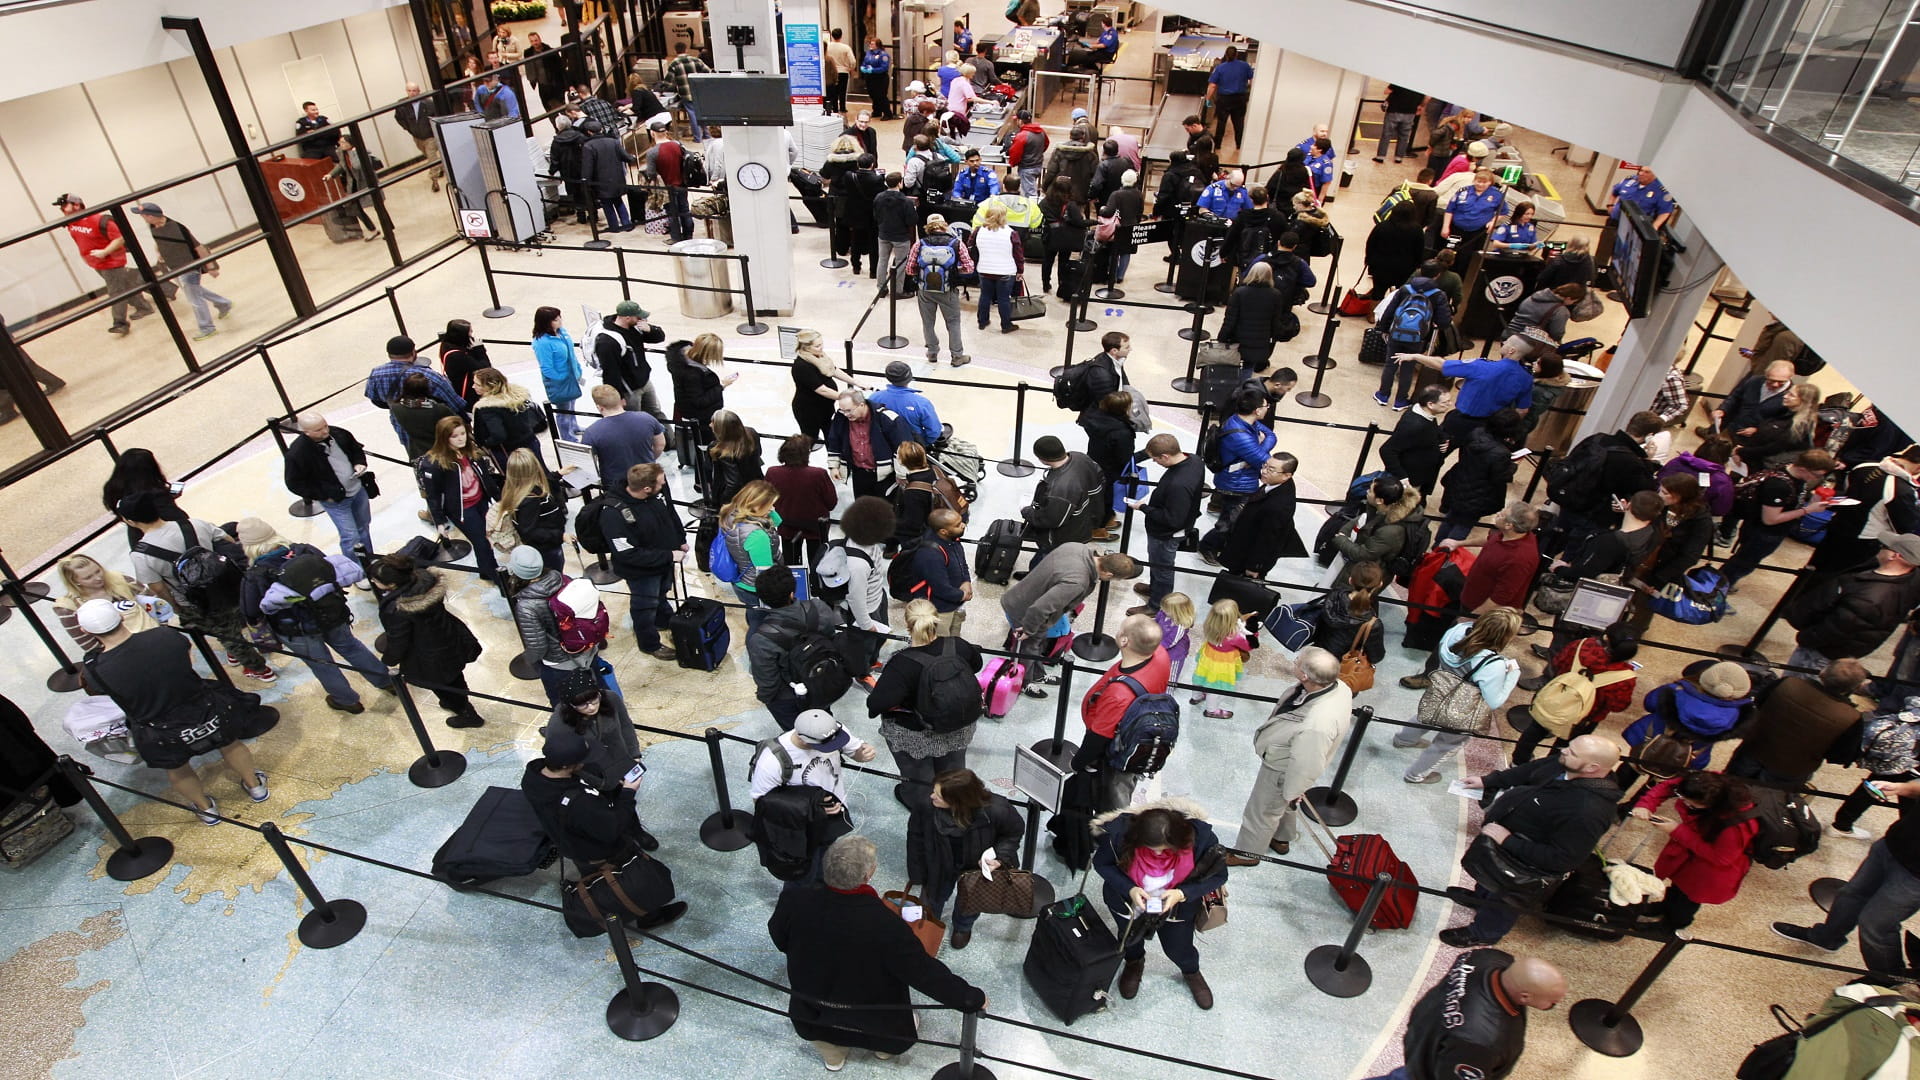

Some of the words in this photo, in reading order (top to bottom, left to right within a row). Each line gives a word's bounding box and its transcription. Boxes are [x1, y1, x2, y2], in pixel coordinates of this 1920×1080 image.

[1132, 224, 1157, 232] Please
[1131, 231, 1149, 239] Wait
[1130, 238, 1149, 246] Here
